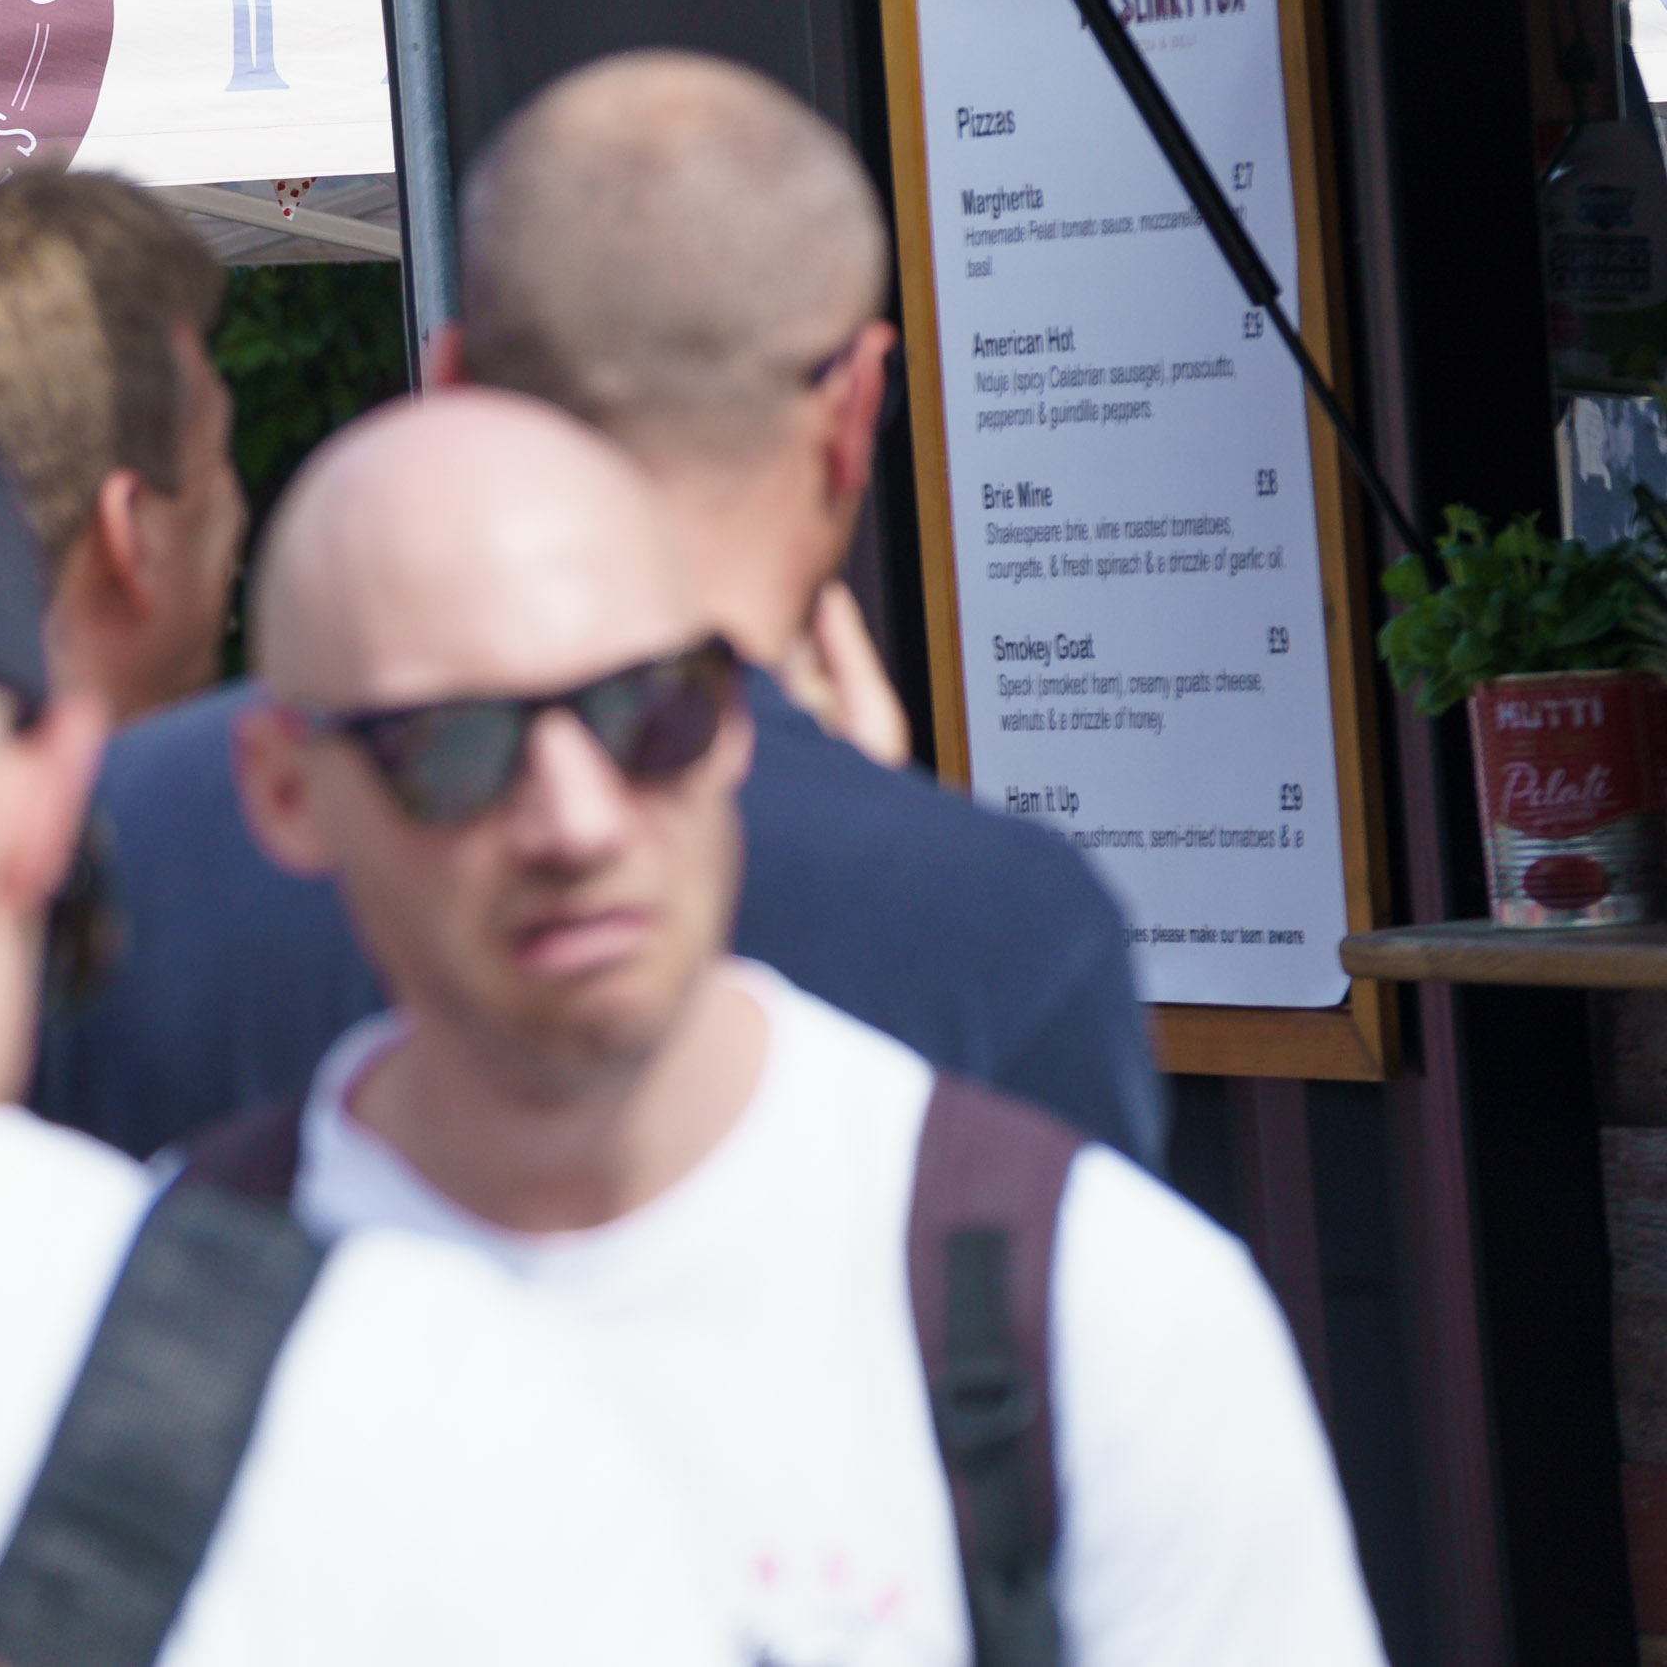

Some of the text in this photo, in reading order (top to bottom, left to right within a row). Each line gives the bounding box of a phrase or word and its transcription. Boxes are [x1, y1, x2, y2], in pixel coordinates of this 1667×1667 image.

[956, 105, 1016, 139] Pizzas
[961, 183, 1044, 219] Margherita
[971, 325, 1076, 358] American Hot
[982, 480, 1053, 509] Brie Mine
[993, 632, 1096, 667] Smokey Goat
[1005, 784, 1042, 814] Ham
[1043, 784, 1056, 812] it
[1280, 782, 1304, 811] £9
